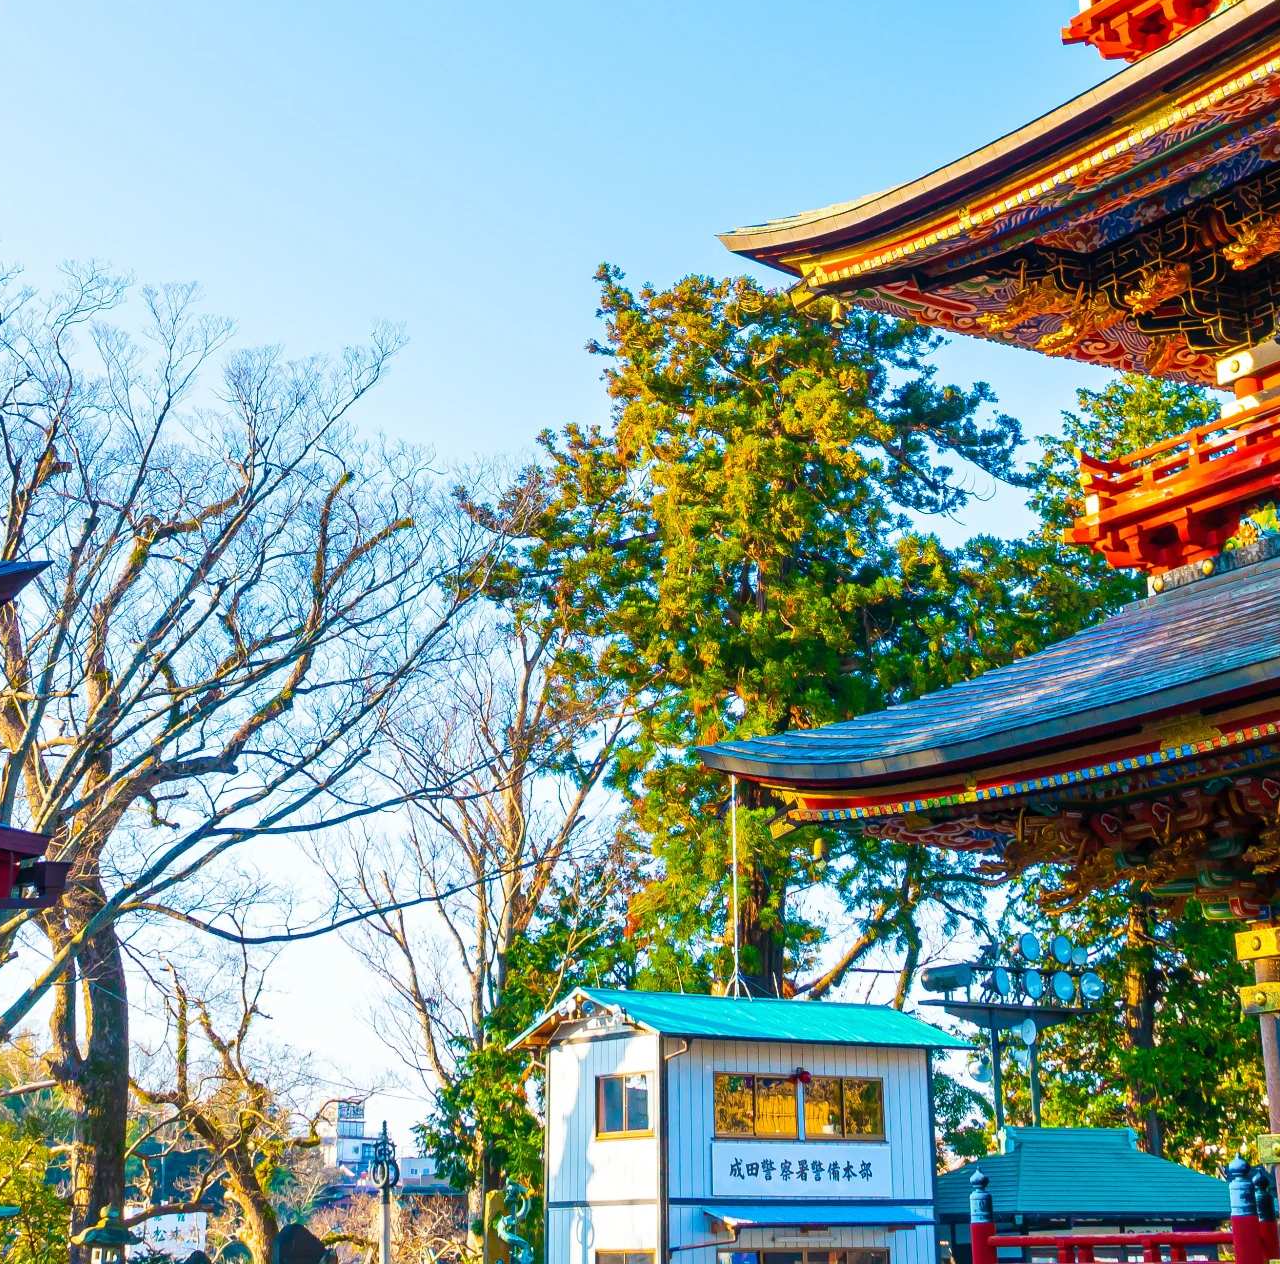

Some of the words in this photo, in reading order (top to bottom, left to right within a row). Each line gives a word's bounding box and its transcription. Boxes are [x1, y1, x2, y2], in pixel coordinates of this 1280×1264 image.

[729, 1157, 873, 1182] 成田警察署警備本部
